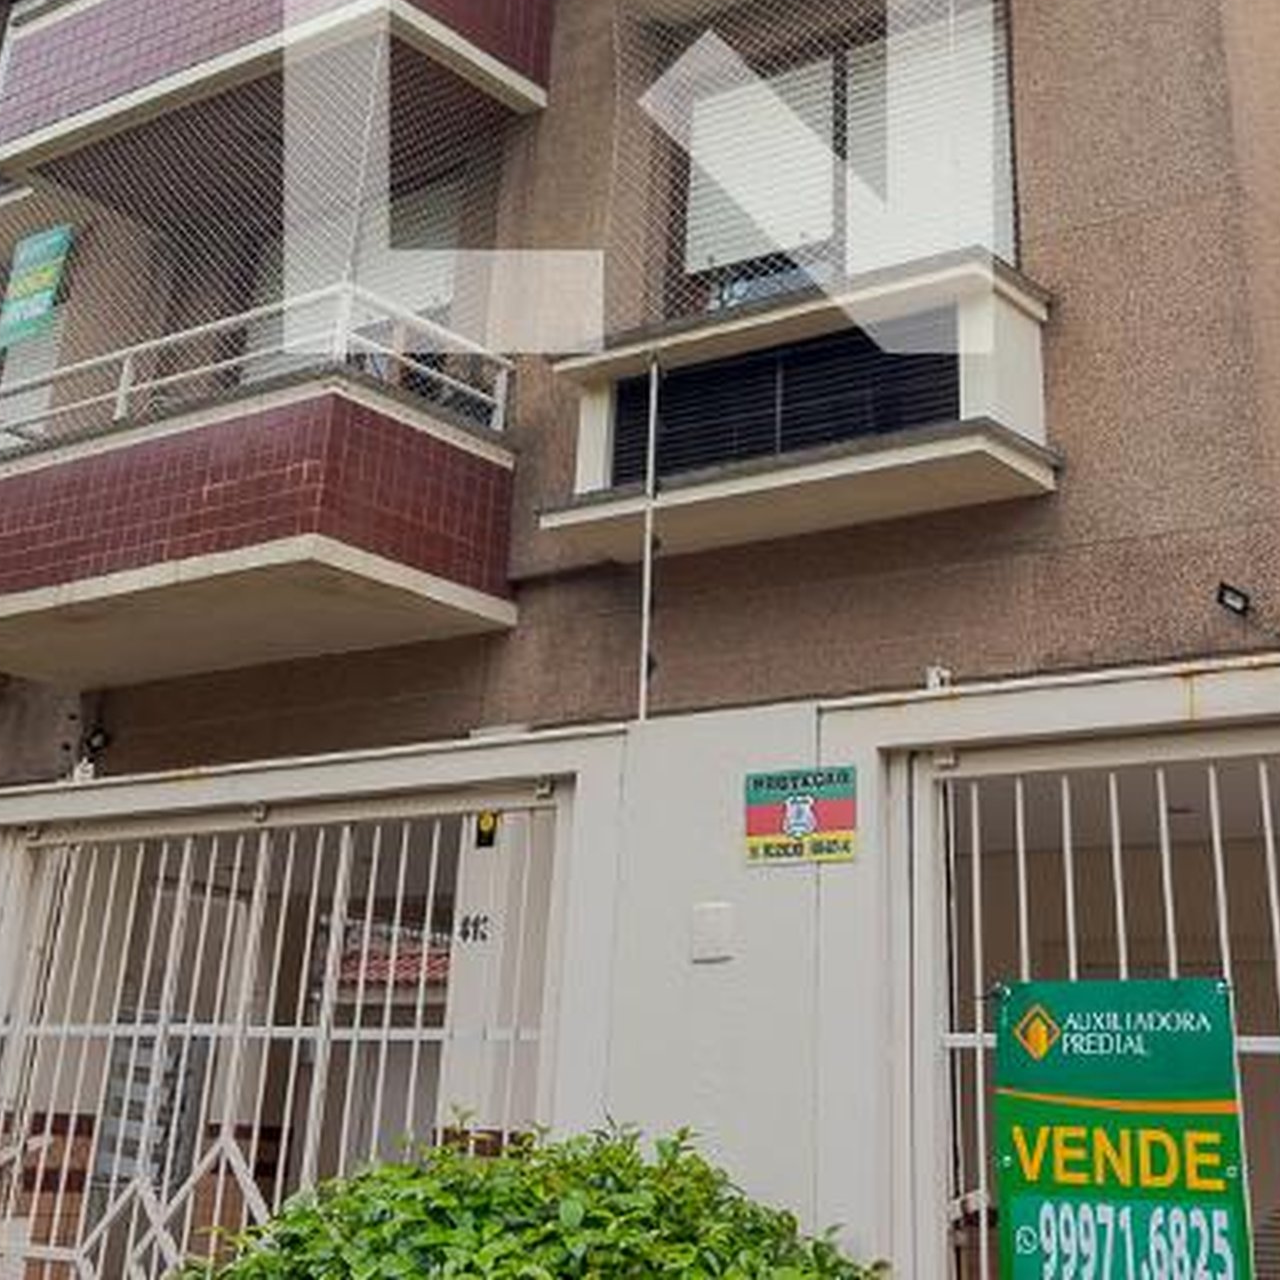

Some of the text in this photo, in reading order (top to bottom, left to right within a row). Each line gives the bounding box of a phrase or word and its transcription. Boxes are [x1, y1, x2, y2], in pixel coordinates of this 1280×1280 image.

[1061, 1011, 1212, 1033] AUXILIADORA
[1061, 1032, 1147, 1055] PREDIAL
[1012, 1125, 1227, 1192] VENDE
